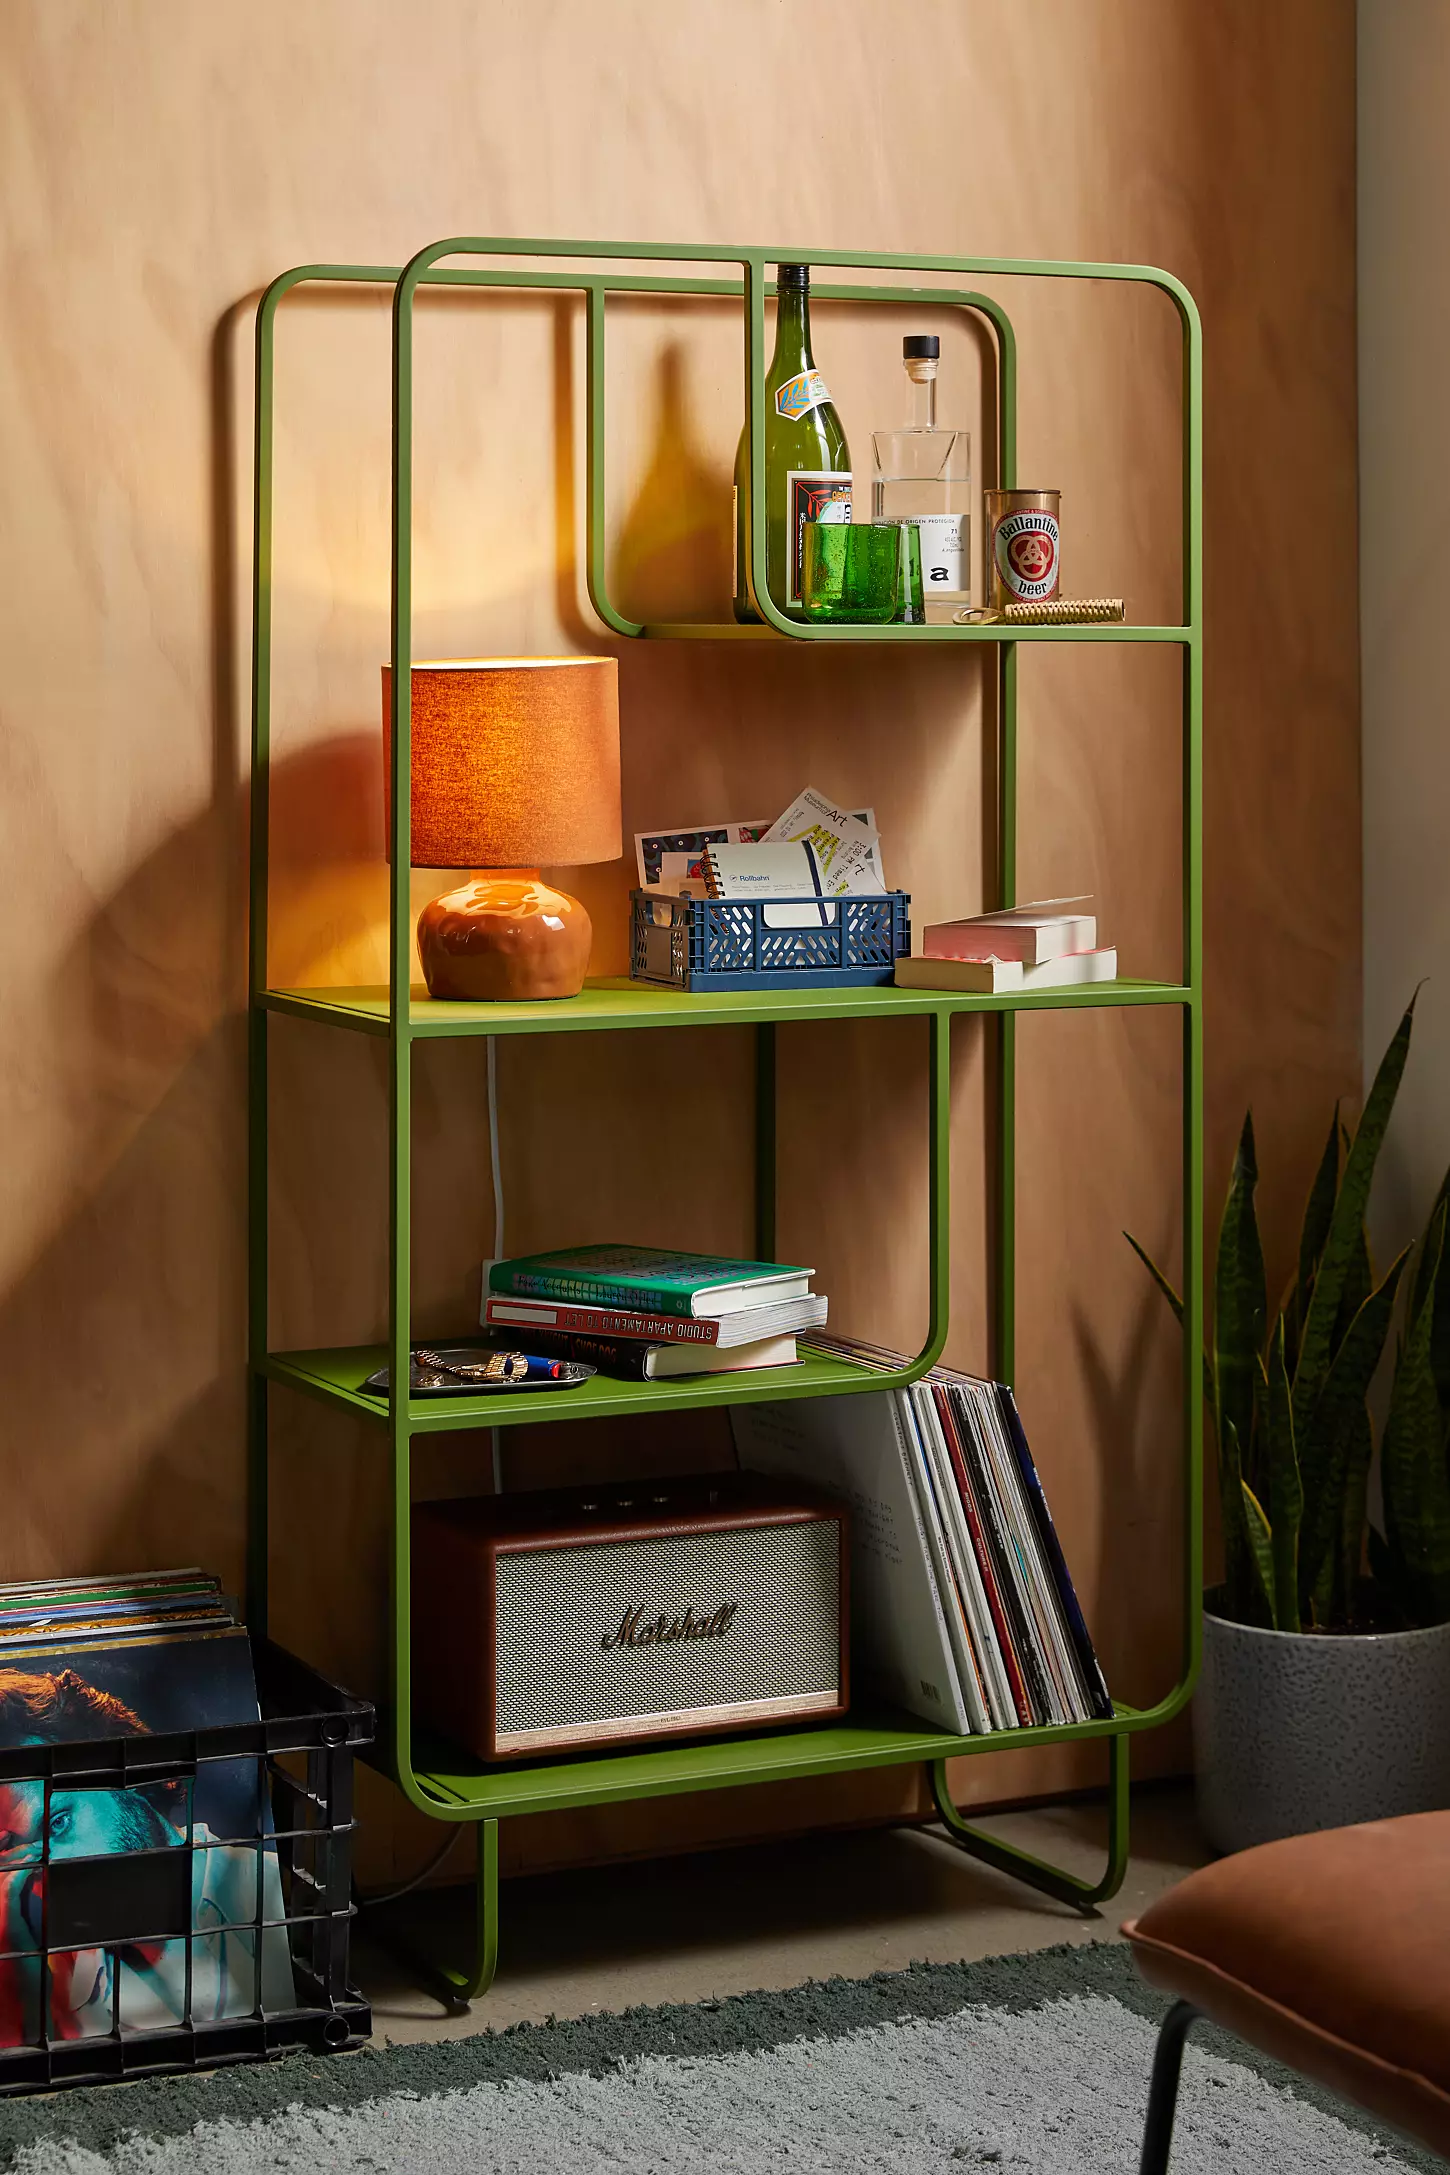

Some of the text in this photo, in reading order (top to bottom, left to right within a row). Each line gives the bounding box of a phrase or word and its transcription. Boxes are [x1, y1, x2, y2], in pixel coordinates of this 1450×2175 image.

[998, 517, 1059, 541] Ballantine
[1017, 580, 1047, 595] beer
[826, 810, 848, 827] Art
[853, 843, 867, 857] 3:00
[832, 864, 849, 881] Timed
[854, 863, 866, 876] rt
[565, 1312, 713, 1341] STUDIO APARTAMENTO TO LET
[964, 1492, 973, 1513] MIGOS
[976, 1538, 986, 1565] CULTURE
[601, 1602, 738, 1650] Marshall
